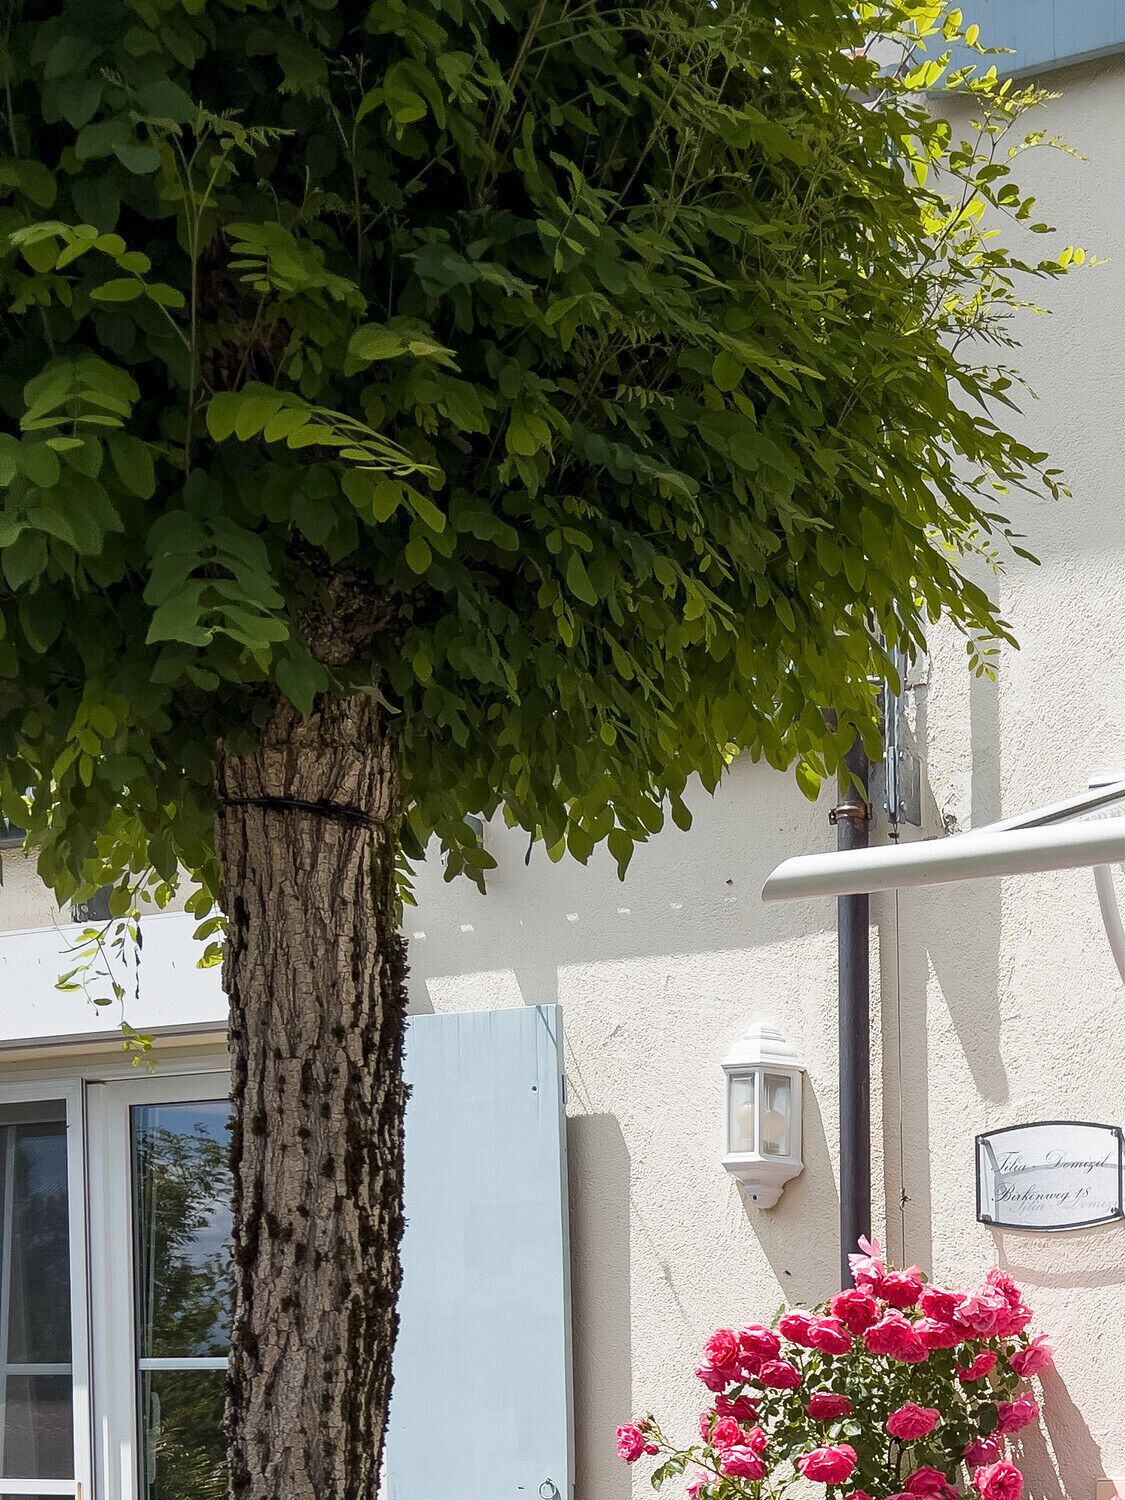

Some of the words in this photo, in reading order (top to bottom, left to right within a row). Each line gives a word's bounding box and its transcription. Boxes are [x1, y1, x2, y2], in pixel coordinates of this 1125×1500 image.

[991, 1151, 1026, 1172] Tilia
[1044, 1149, 1113, 1174] Domizil
[991, 1182, 1069, 1205] Birkenweg
